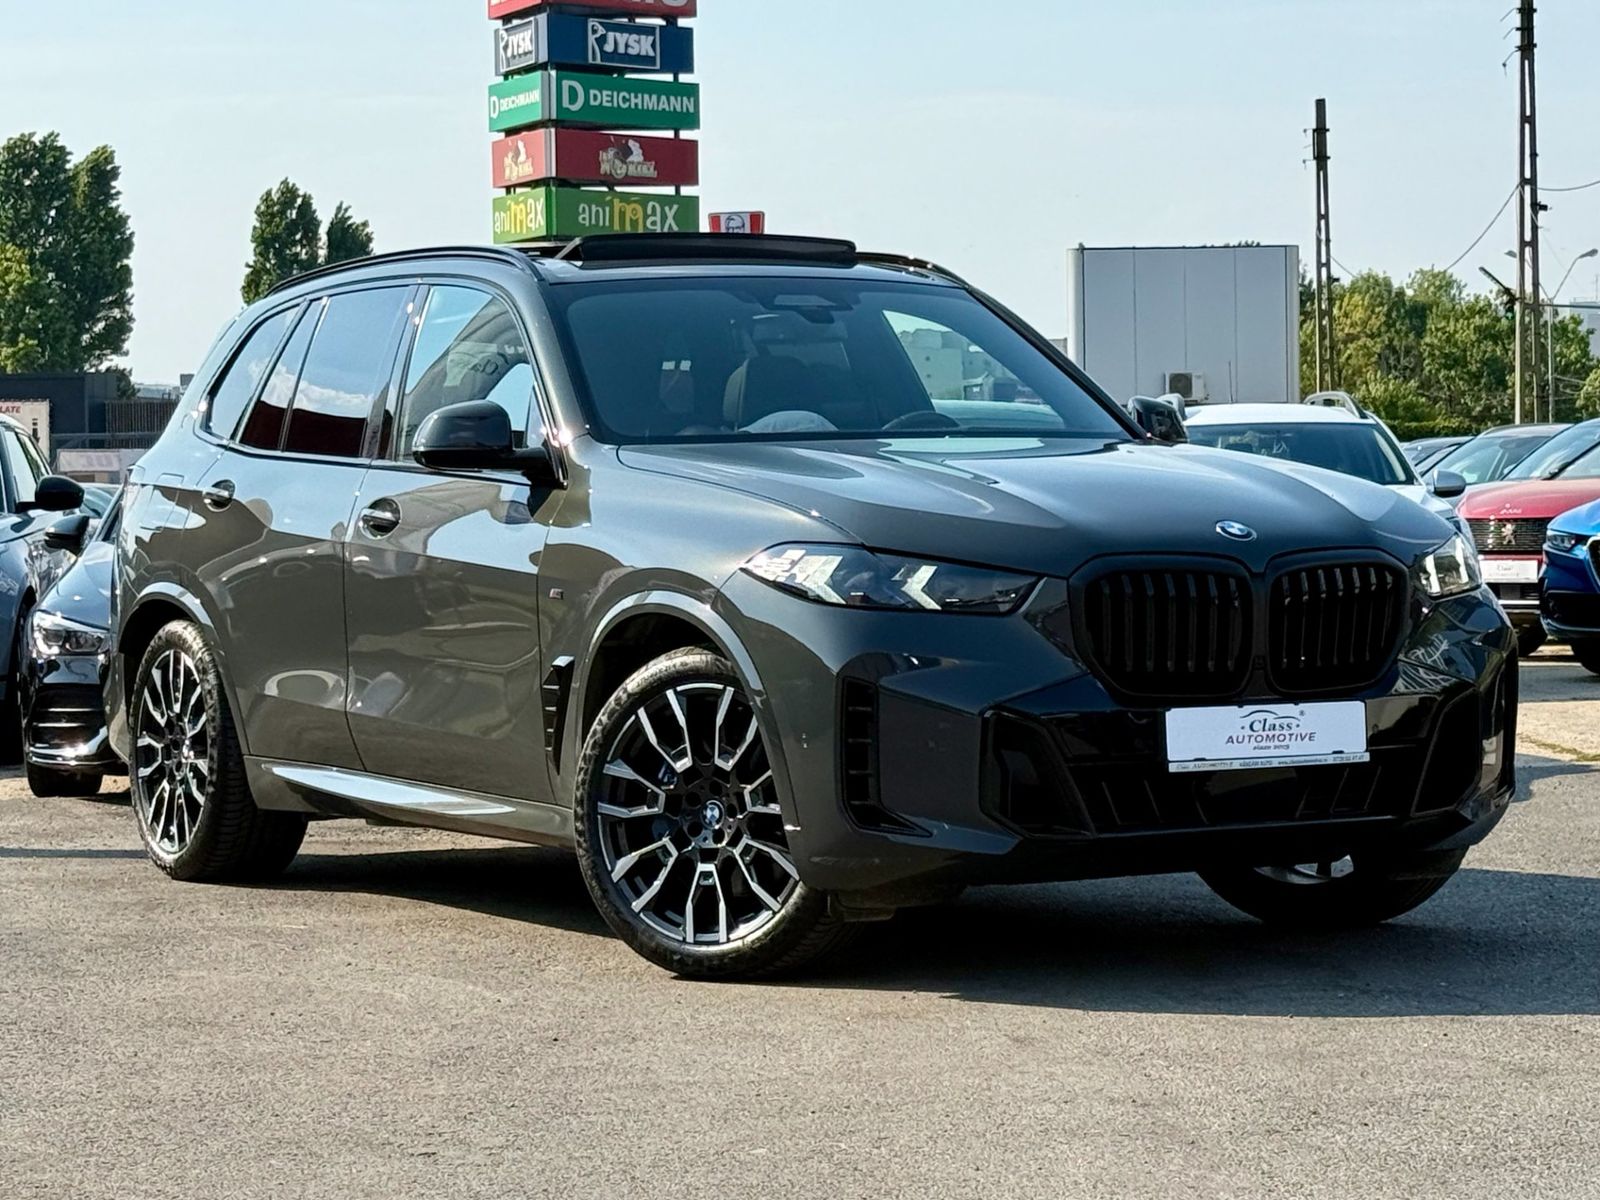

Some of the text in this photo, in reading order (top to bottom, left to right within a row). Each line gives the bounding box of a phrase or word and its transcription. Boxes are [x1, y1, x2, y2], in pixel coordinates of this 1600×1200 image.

[507, 29, 533, 58] JYSK
[603, 32, 656, 57] JYSK
[489, 88, 540, 119] D DEICHMANN
[561, 80, 695, 113] D DEICHMANN
[1225, 731, 1317, 745] AUTOMOTIVE
[1249, 718, 1293, 733] Class
